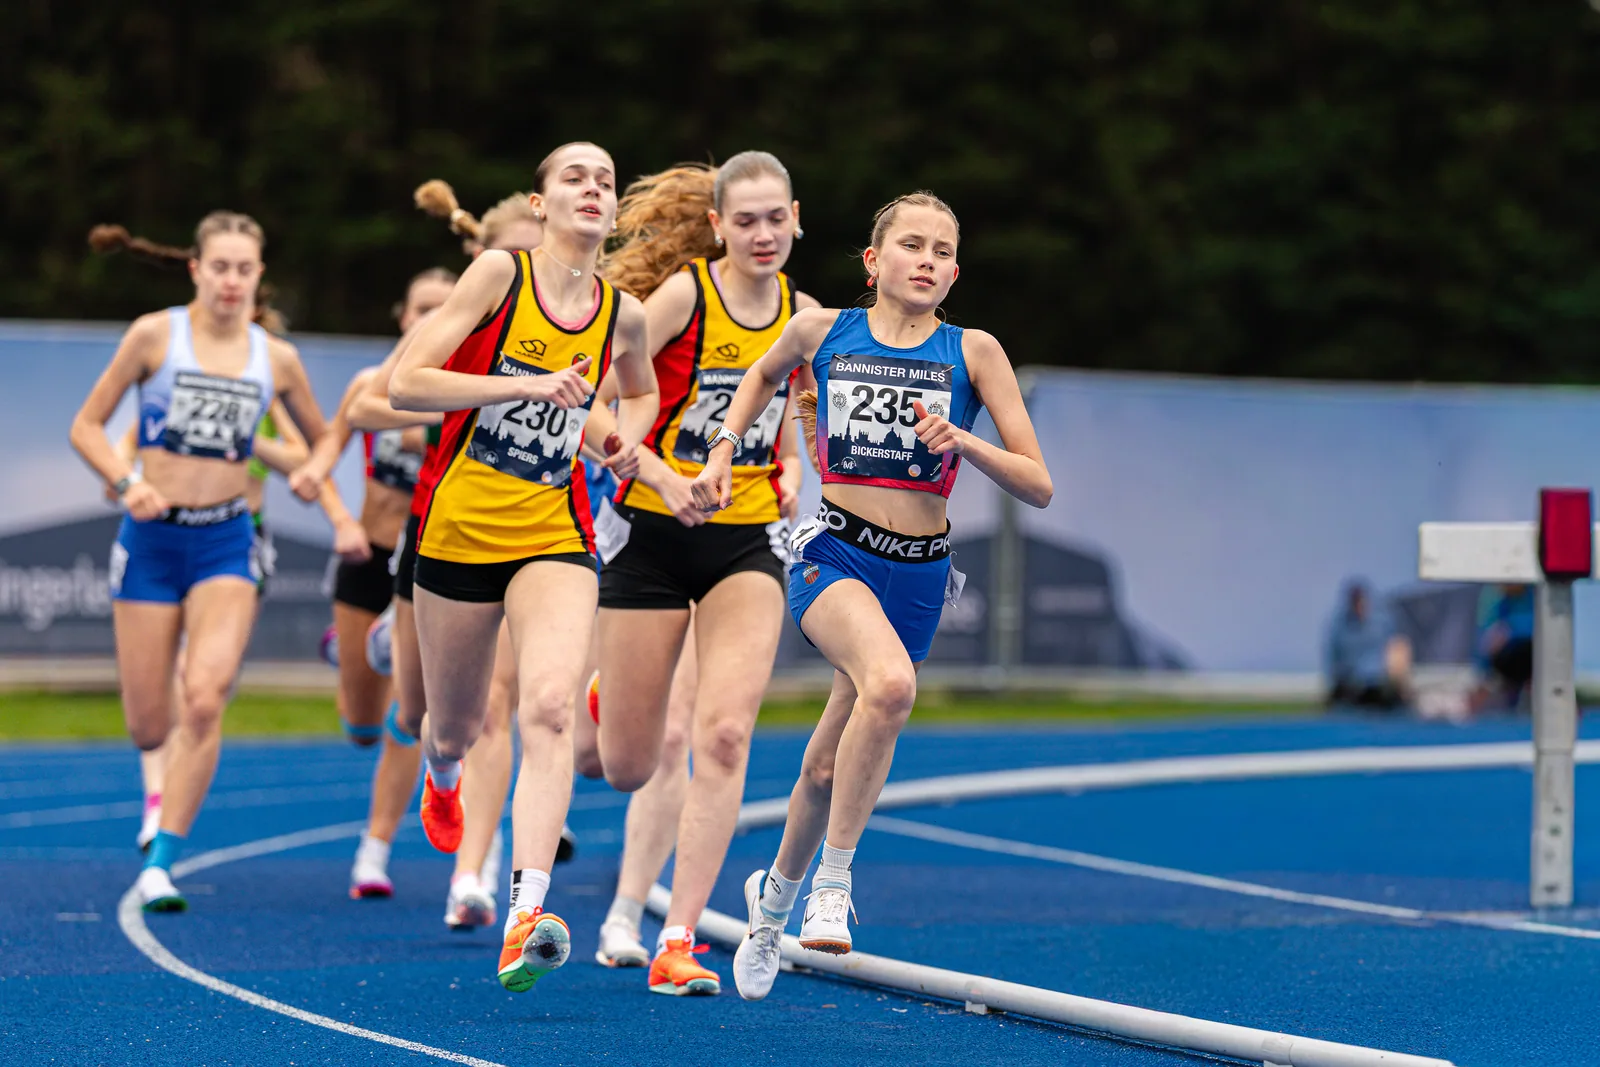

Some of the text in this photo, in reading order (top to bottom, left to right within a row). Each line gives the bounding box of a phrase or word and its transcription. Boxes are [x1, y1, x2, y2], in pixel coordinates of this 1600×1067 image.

[836, 362, 946, 382] BANNISTER MILES
[189, 397, 240, 425] 228
[503, 400, 568, 437] 230
[849, 385, 923, 427] 235
[507, 447, 539, 465] SPIERS
[851, 445, 913, 461] BICKERSTAFF
[857, 527, 927, 557] NIKE
